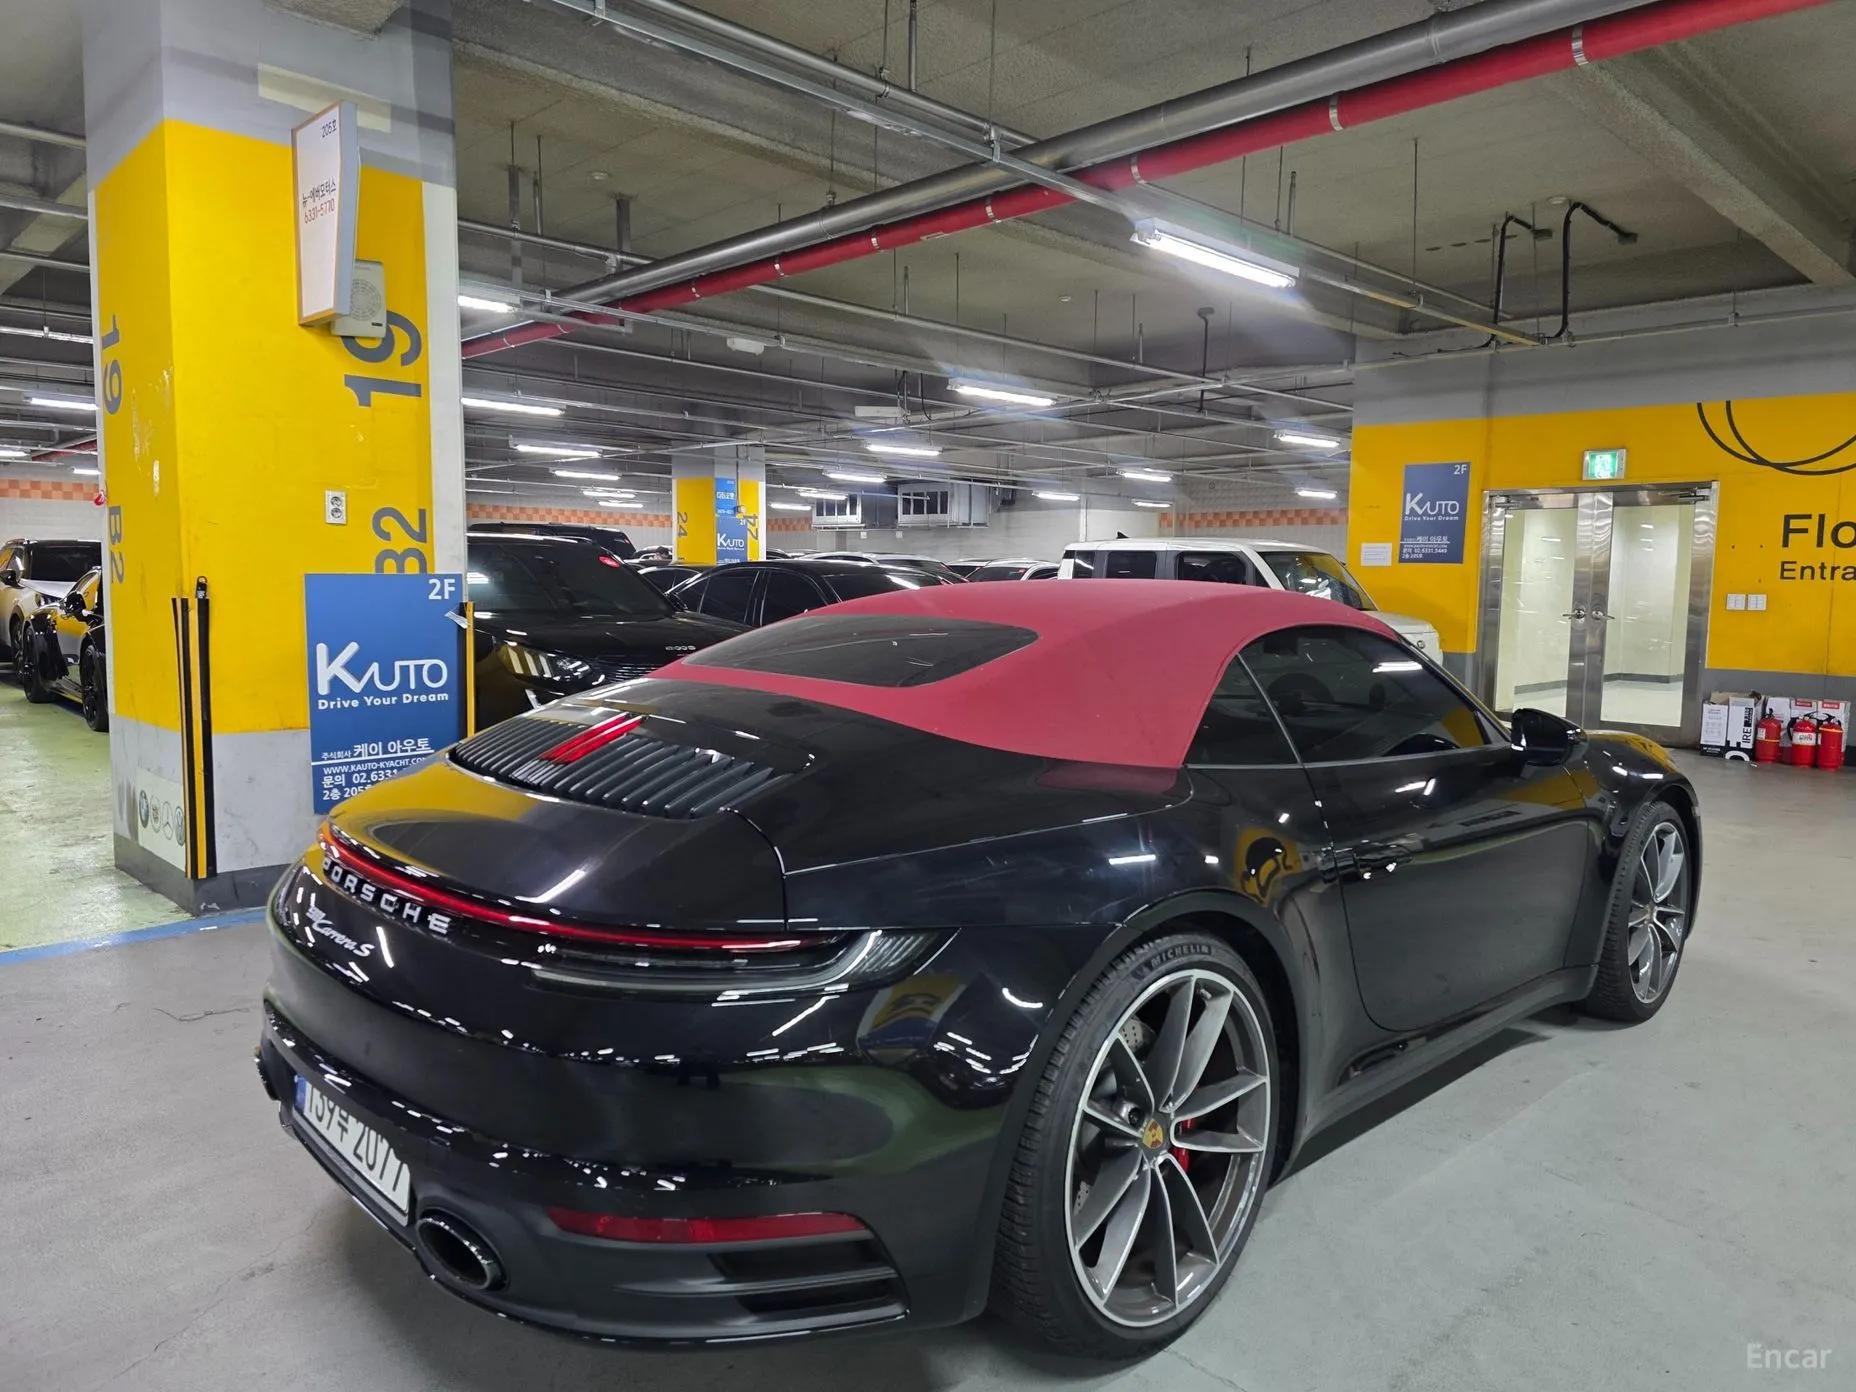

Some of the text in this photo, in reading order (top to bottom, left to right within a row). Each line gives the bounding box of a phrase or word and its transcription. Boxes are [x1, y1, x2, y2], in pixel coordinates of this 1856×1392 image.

[321, 119, 337, 138] 205호
[304, 198, 335, 224] 6331-5770
[101, 314, 123, 415] 19
[341, 310, 423, 407] 19
[1453, 464, 1468, 475] 2F
[677, 511, 688, 537] 24
[1782, 513, 1856, 549] Flo
[109, 505, 125, 584] B2
[1780, 561, 1856, 581] Entra
[428, 579, 456, 600] 2F
[318, 692, 448, 710] Drive Your Dream
[322, 738, 431, 760] 주식회사 케이 아우토
[322, 774, 345, 789] 문의
[322, 785, 372, 800] 2층 205
[323, 856, 451, 935] PORSCHE
[312, 919, 375, 957] Carrera S
[1150, 944, 1210, 967] MICHELIN
